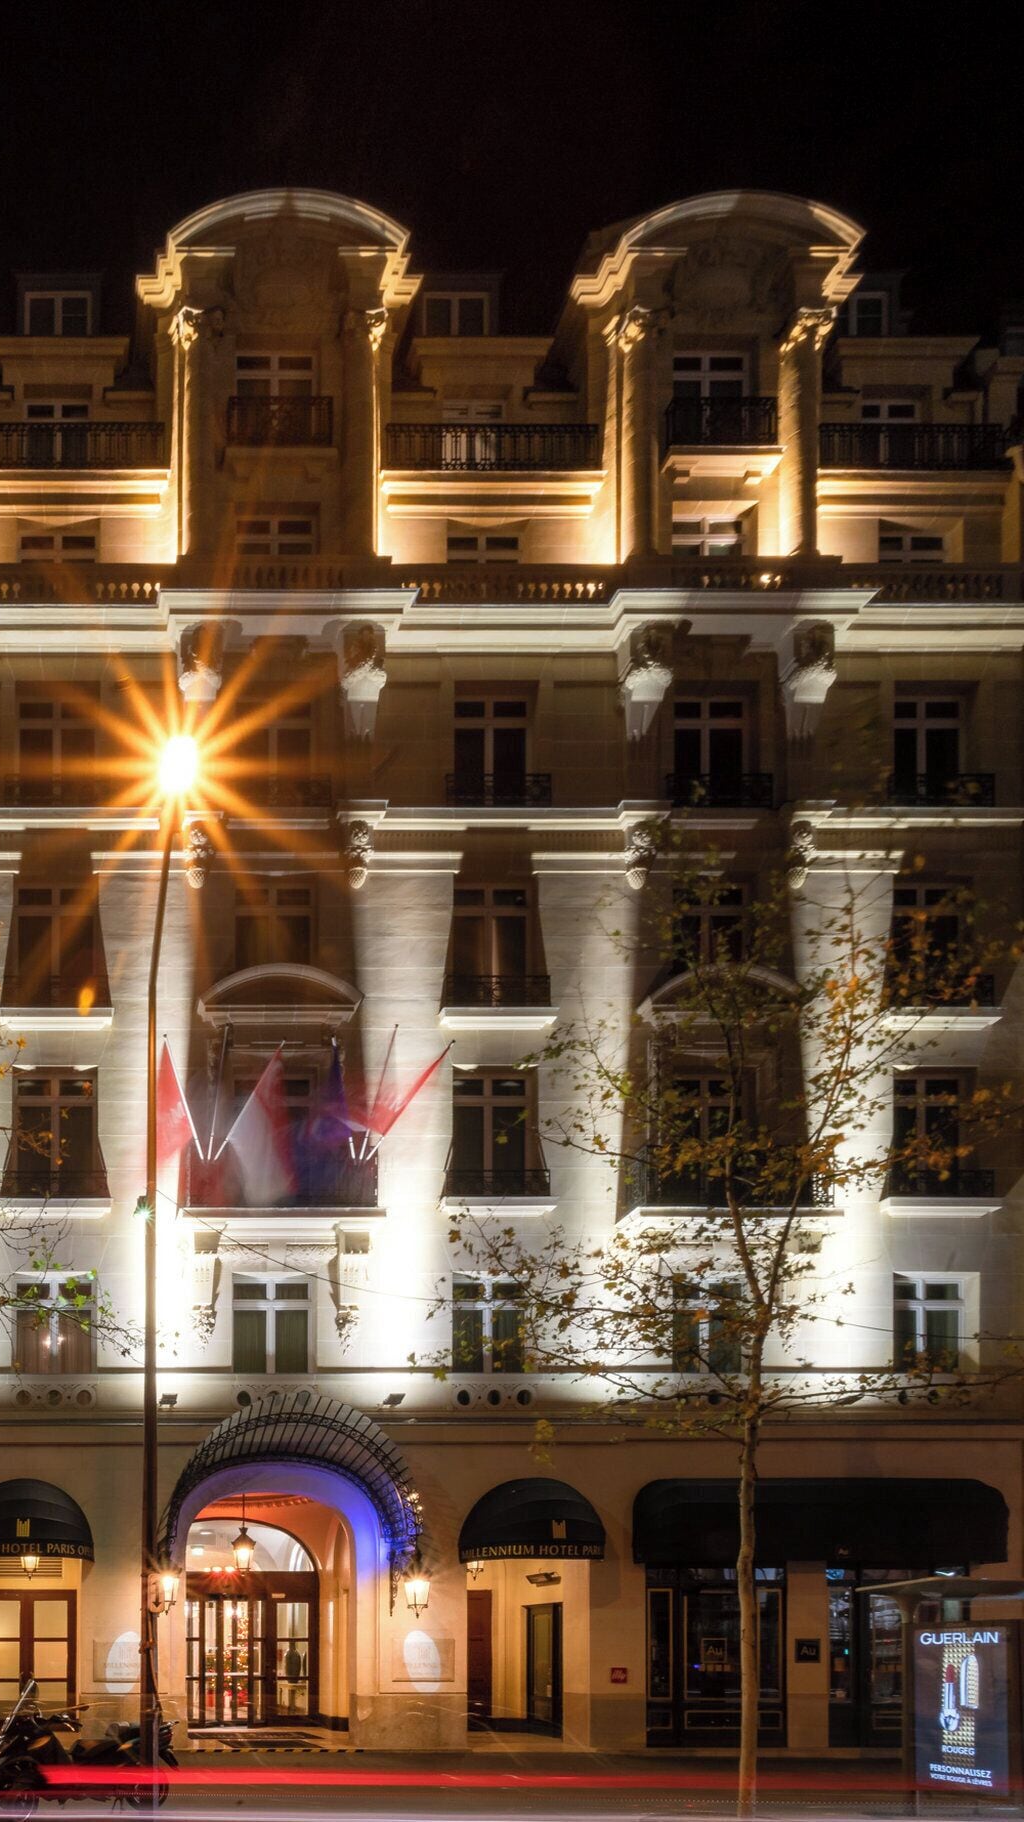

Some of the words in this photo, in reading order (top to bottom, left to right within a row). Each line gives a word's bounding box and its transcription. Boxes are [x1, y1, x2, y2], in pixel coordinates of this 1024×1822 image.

[2, 1543, 42, 1553] HOTEL
[47, 1543, 74, 1554] PARIS
[539, 1545, 579, 1555] HOTEL
[920, 1632, 998, 1645] GUERLAIN
[707, 1646, 723, 1656] Au
[800, 1646, 816, 1655] Au
[929, 1763, 992, 1779] PERSONNALISEZ
